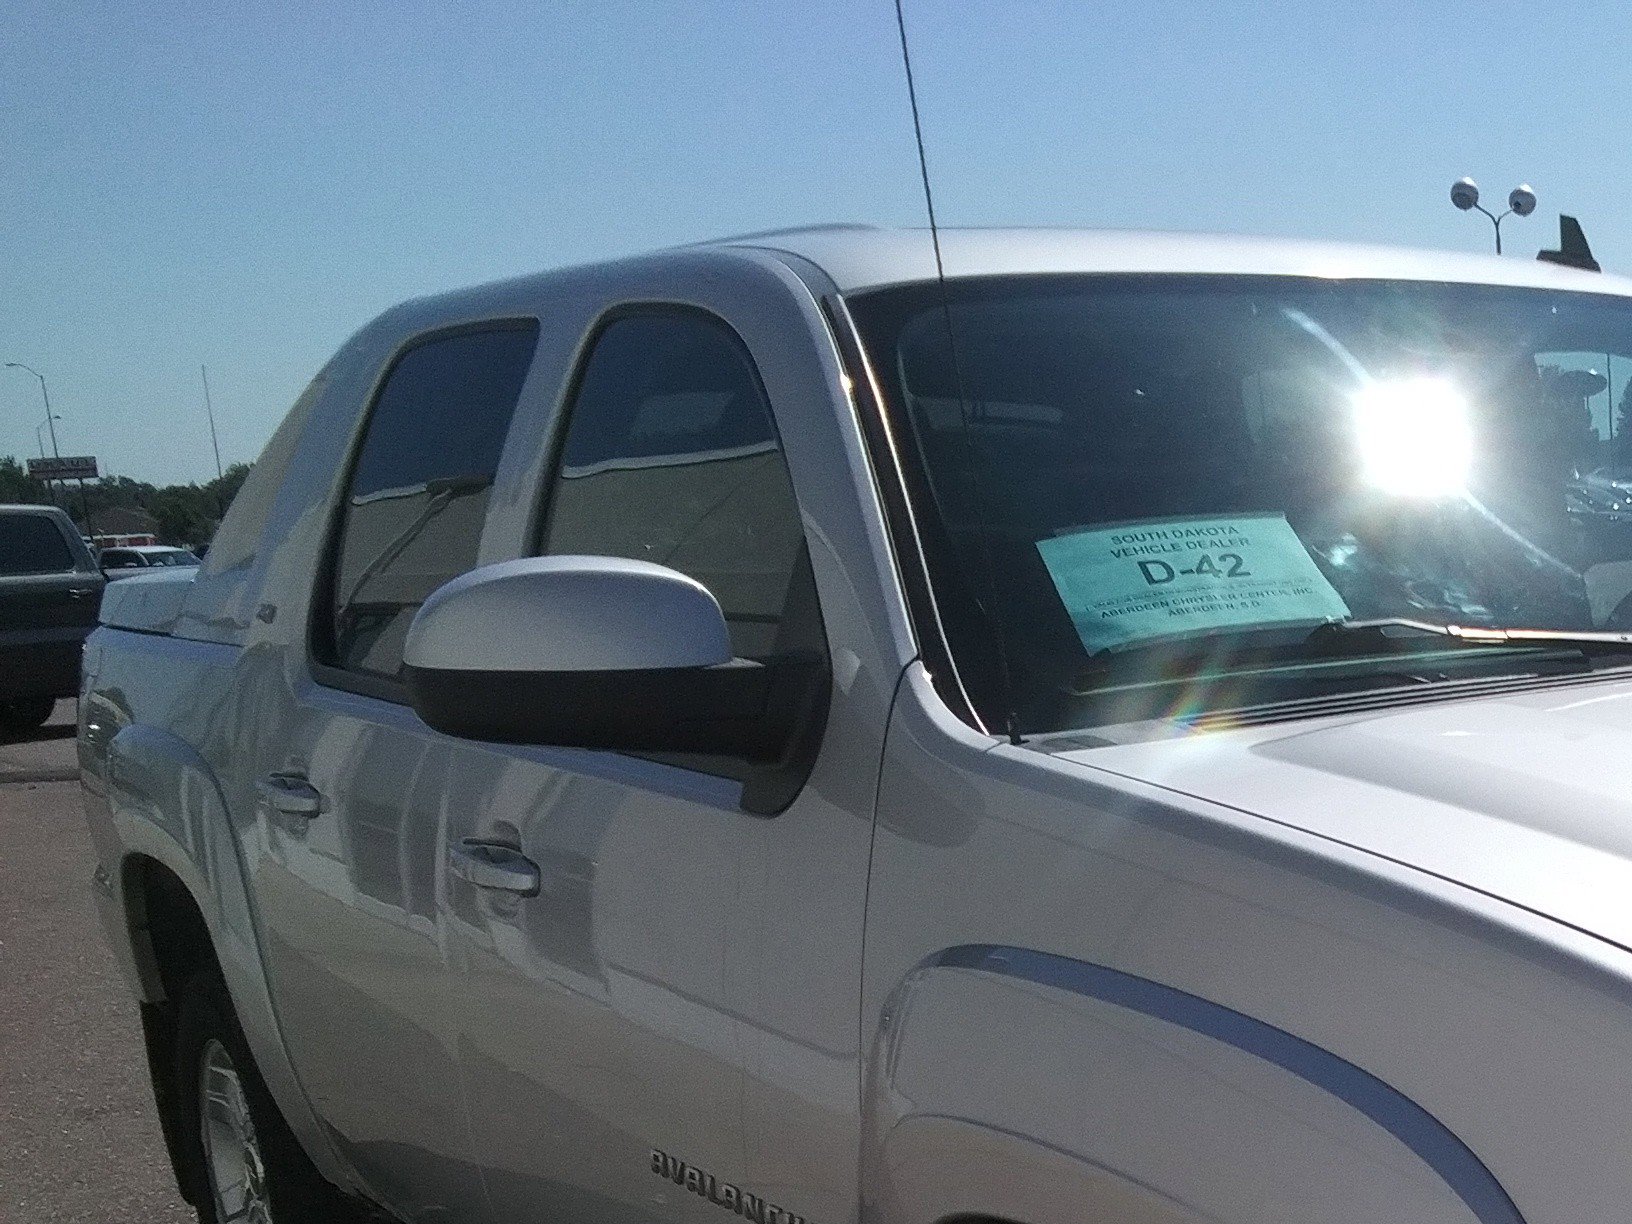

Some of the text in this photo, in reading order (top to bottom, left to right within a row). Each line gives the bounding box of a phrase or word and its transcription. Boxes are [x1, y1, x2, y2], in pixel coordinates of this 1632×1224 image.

[1111, 526, 1239, 545] SOUTH DAKOTA
[1110, 537, 1250, 558] VEHICLE DEALER
[1137, 553, 1251, 585] D-42
[1101, 600, 1169, 618] ABERDEEN
